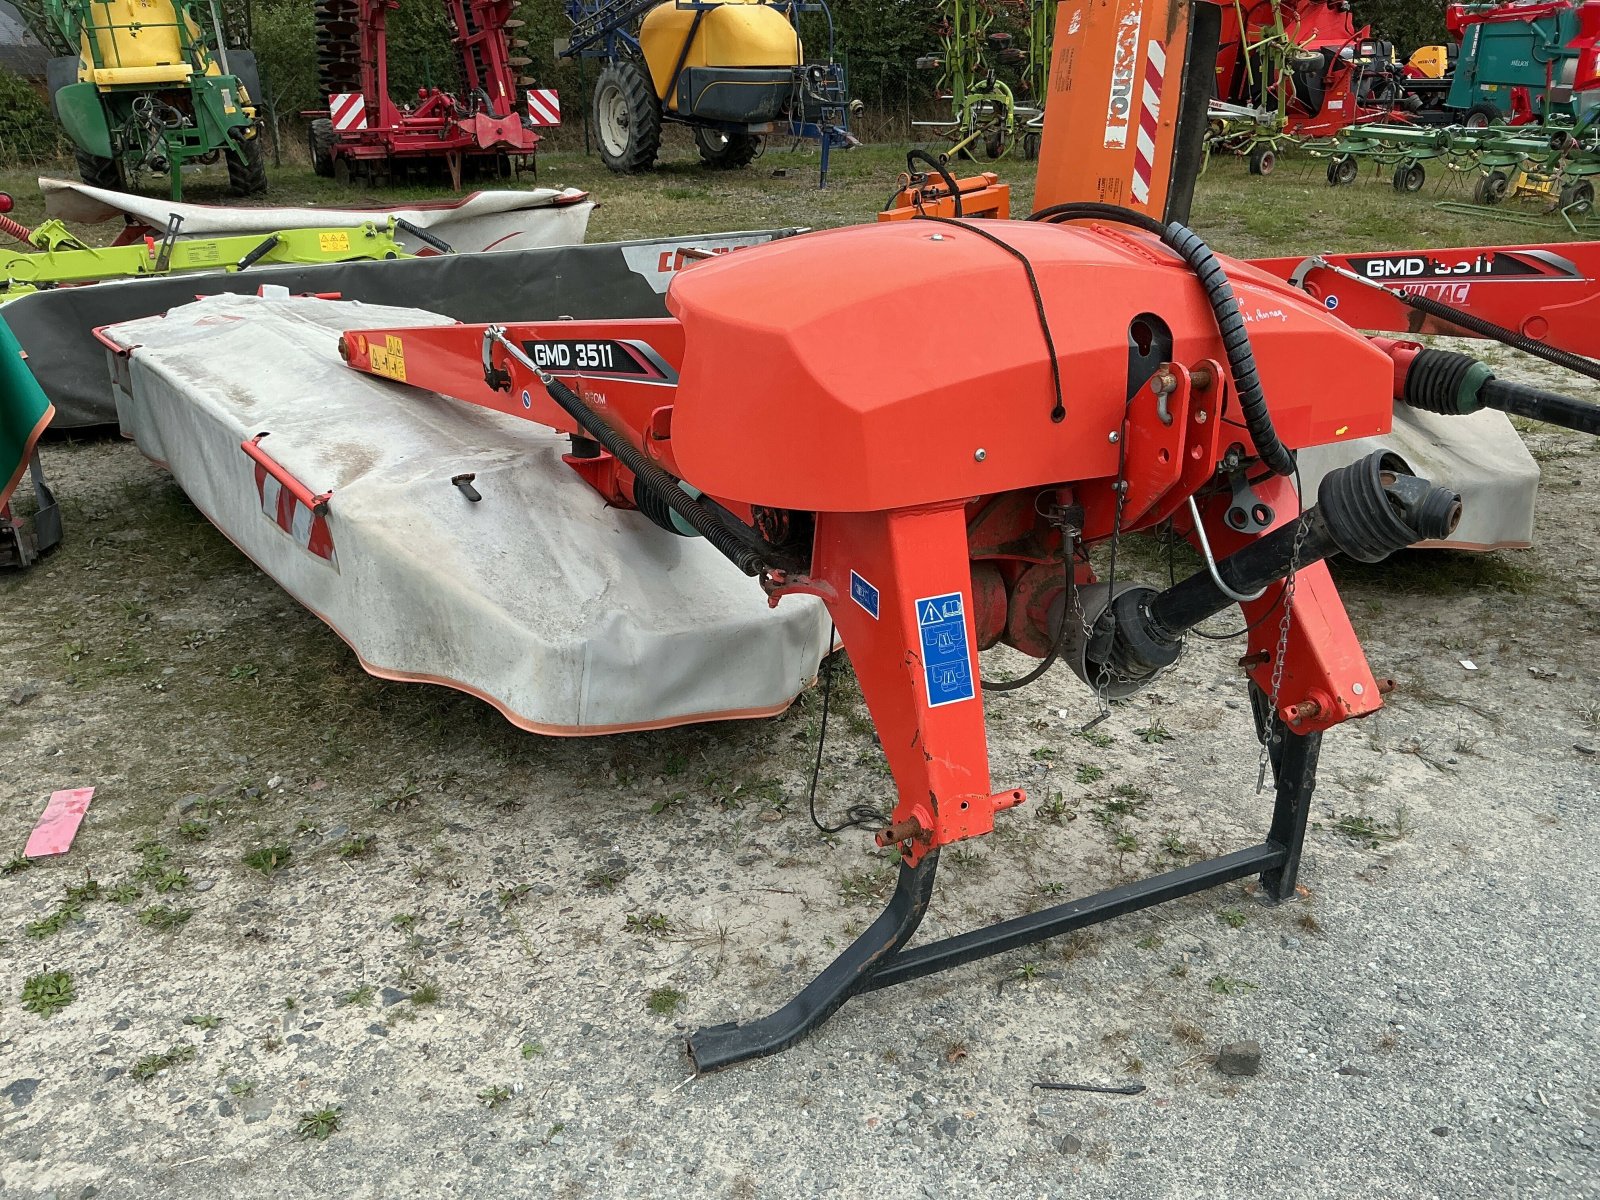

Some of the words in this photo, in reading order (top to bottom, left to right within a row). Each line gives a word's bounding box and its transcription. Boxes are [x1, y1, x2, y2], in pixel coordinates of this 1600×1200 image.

[1366, 258, 1425, 277] GMD
[534, 344, 570, 366] GMD
[575, 344, 613, 368] 3511
